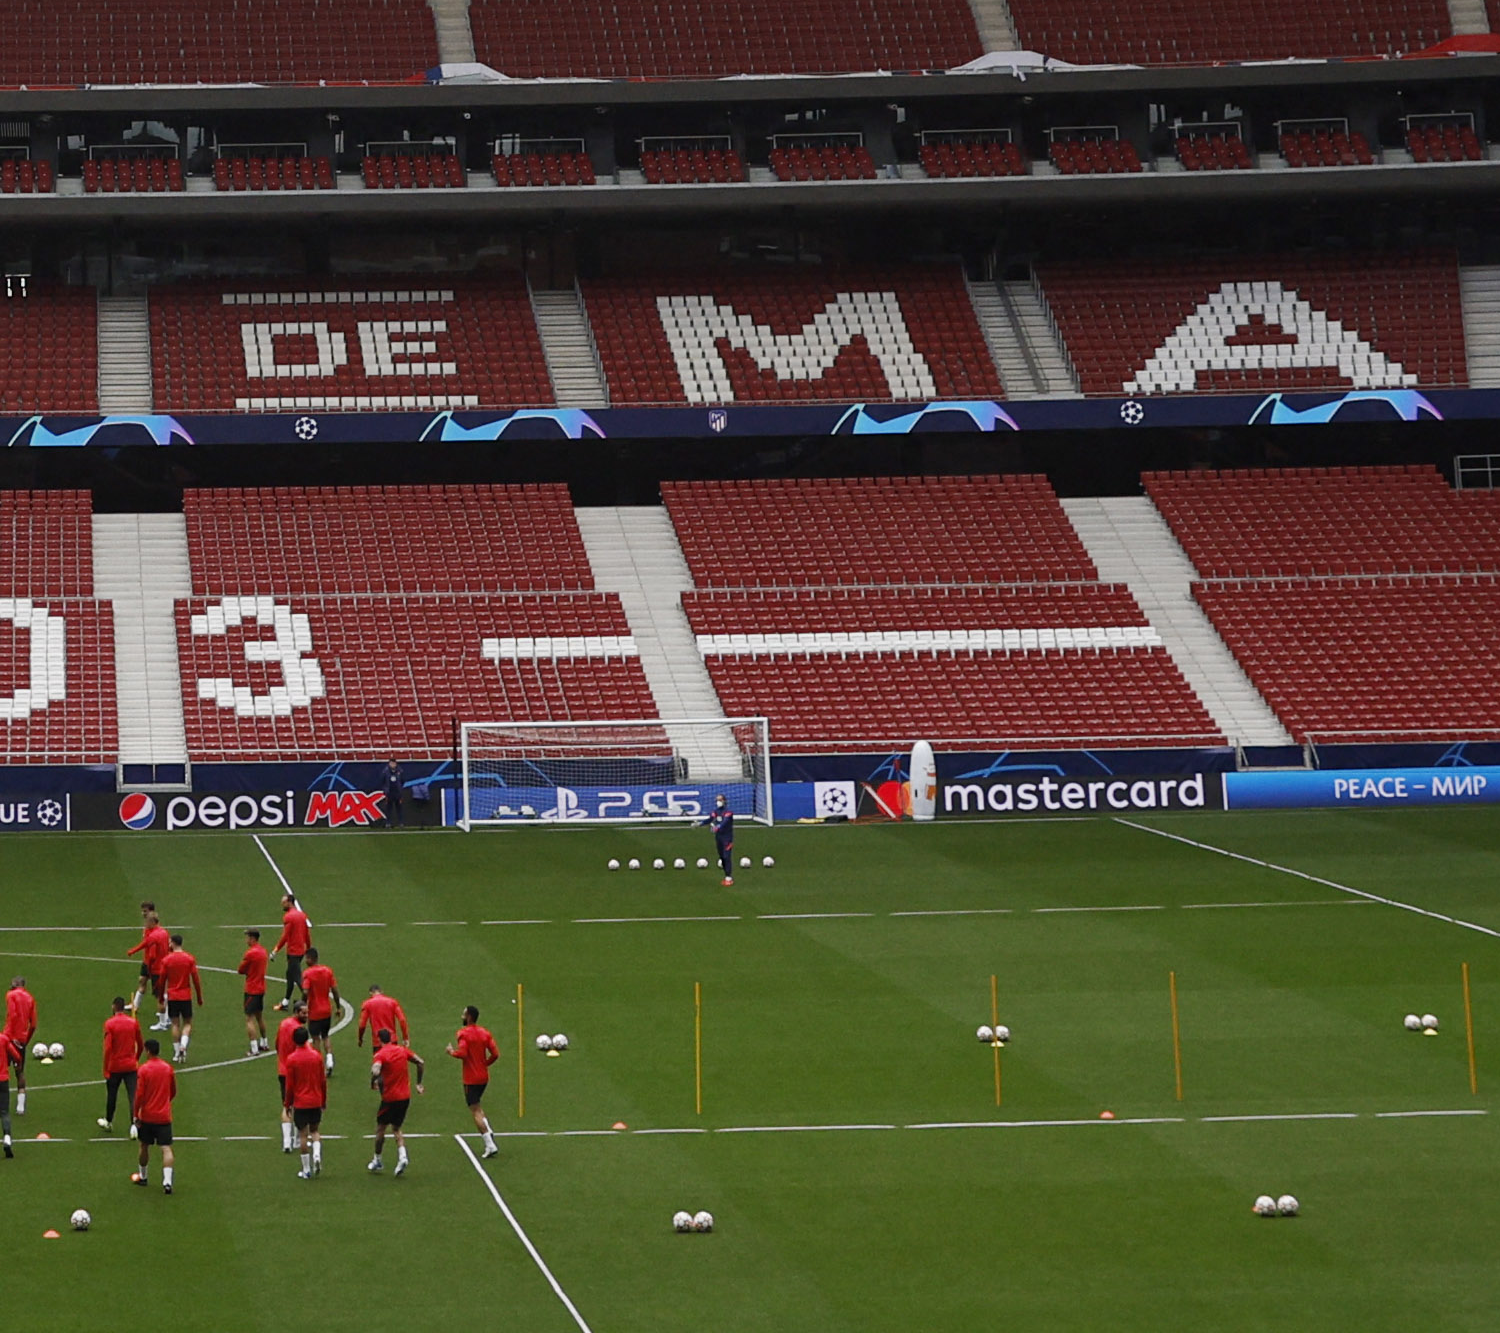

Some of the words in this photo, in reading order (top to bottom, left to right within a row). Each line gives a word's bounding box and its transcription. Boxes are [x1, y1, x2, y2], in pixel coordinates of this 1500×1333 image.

[241, 318, 458, 379] DE
[943, 774, 1203, 812] mastercard
[1334, 777, 1406, 799] PEACE
[165, 791, 294, 830] pepsi
[303, 790, 386, 826] MAX
